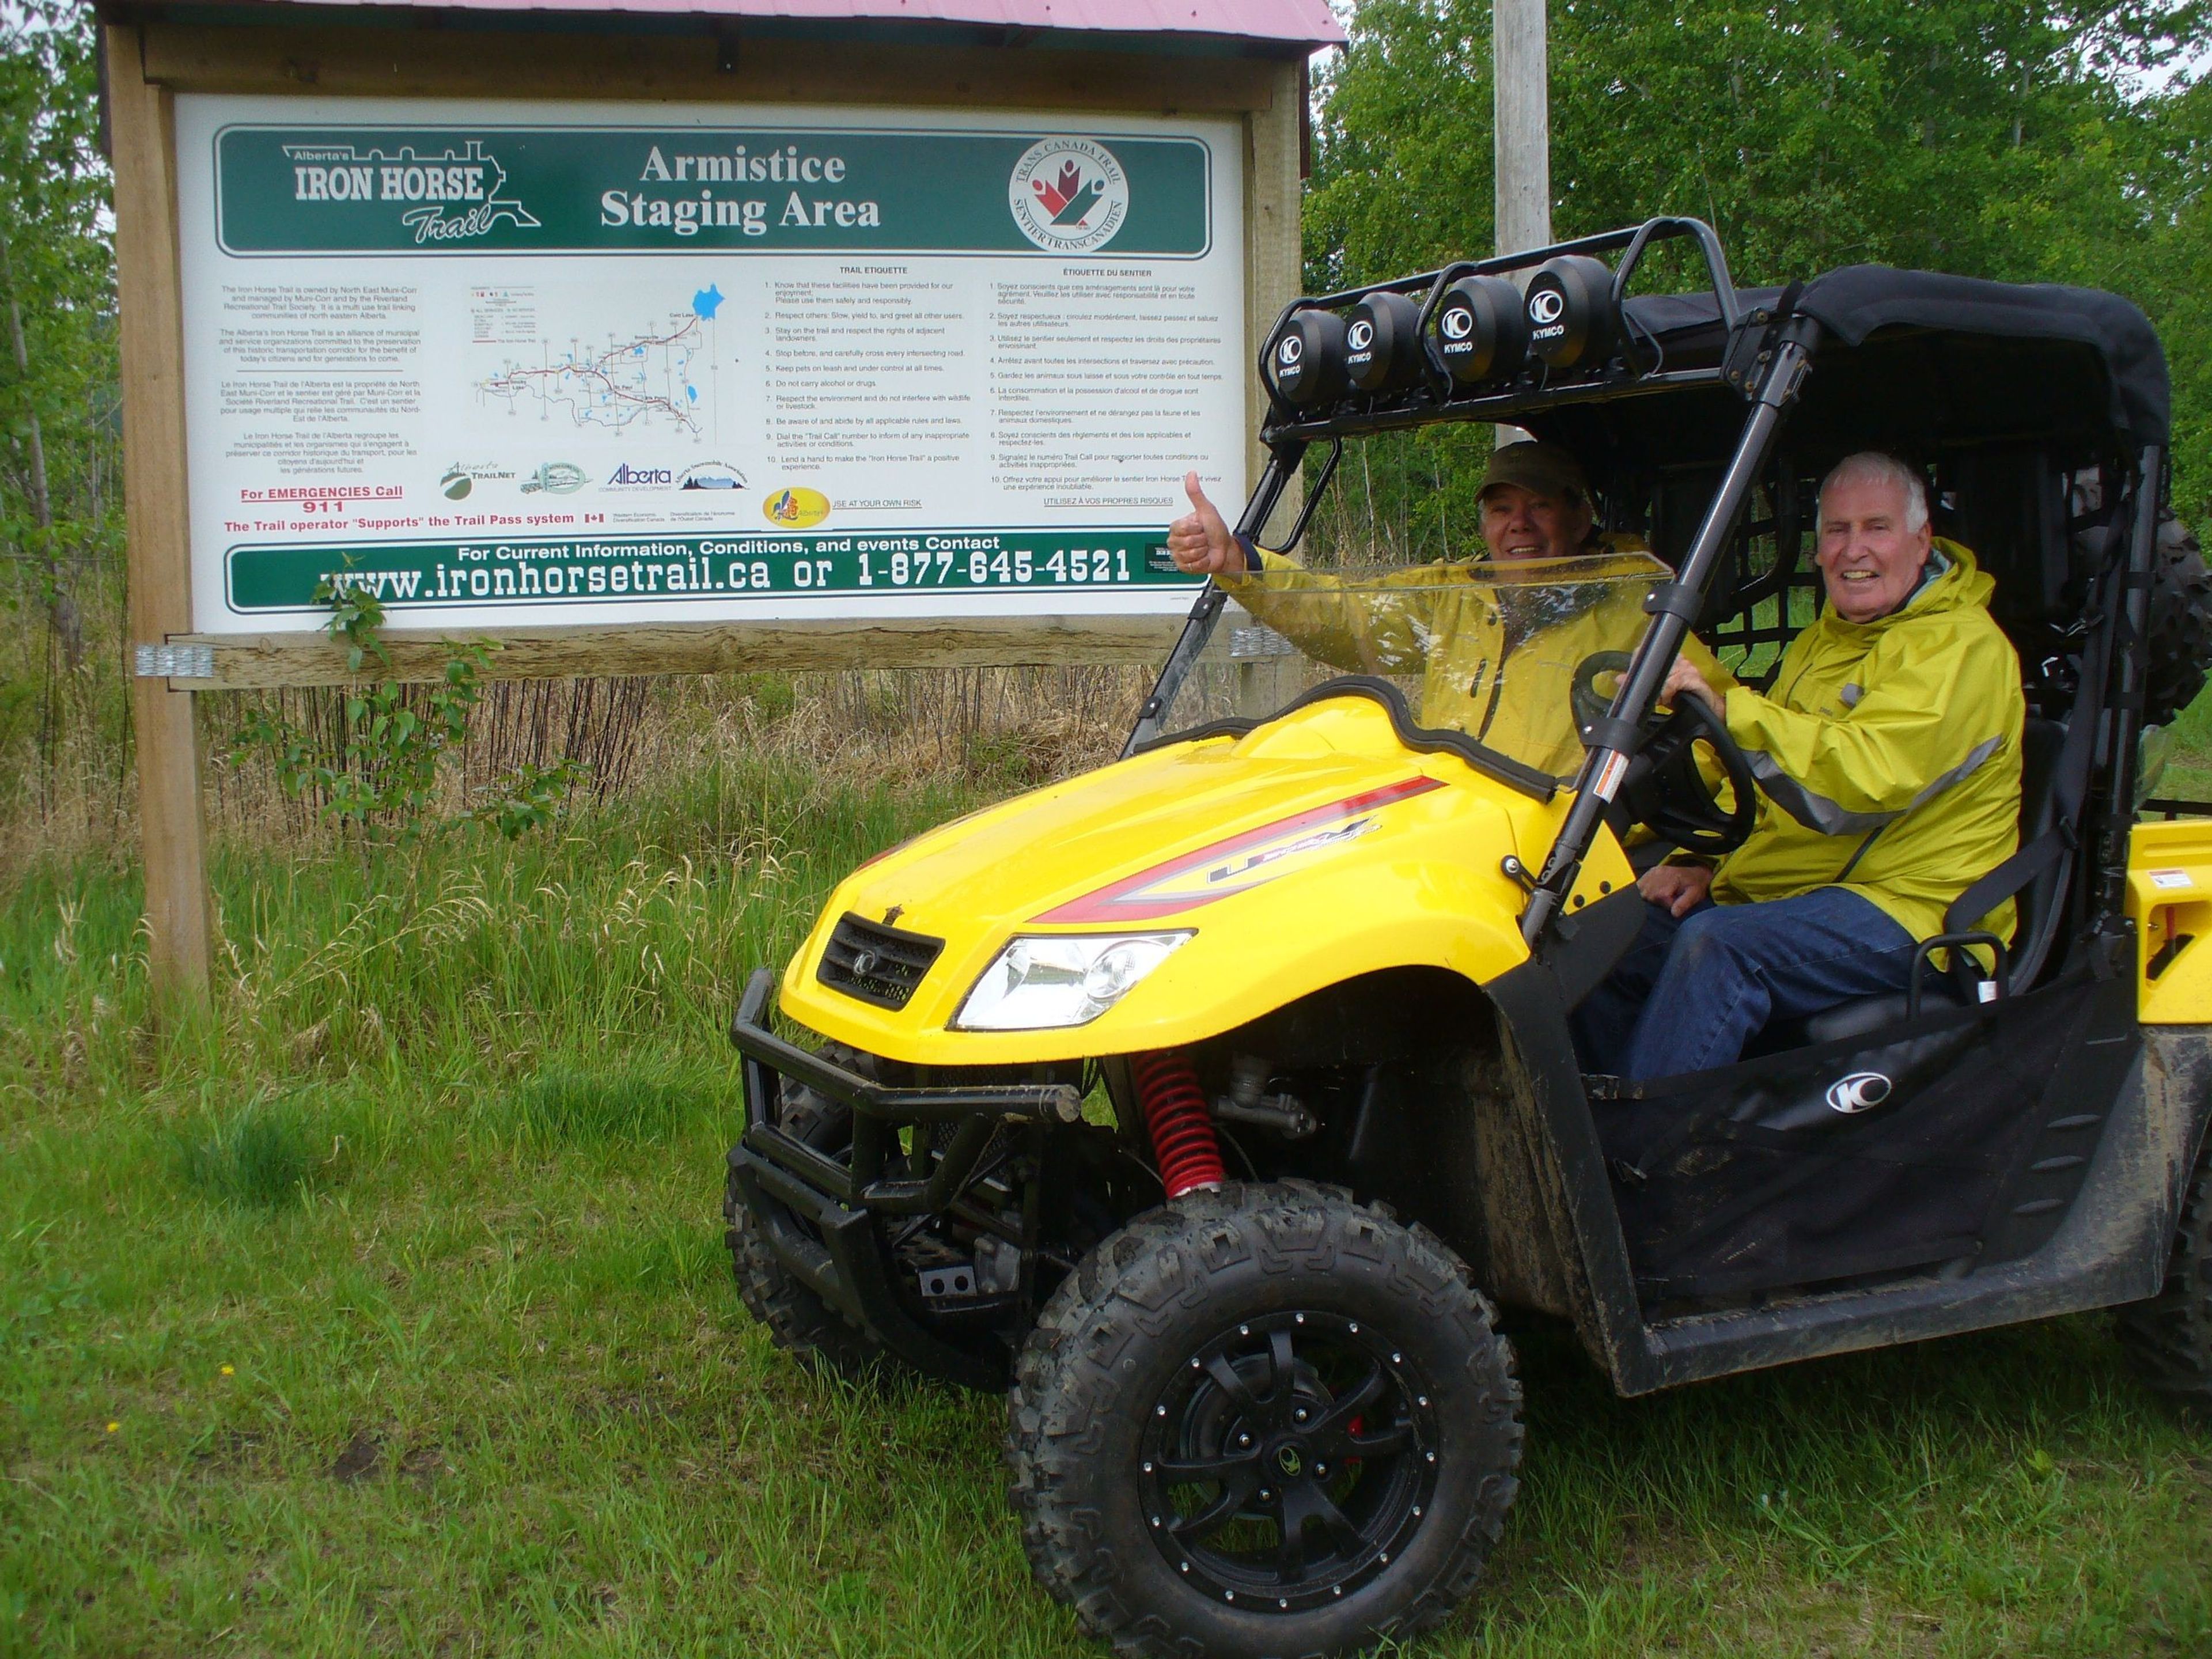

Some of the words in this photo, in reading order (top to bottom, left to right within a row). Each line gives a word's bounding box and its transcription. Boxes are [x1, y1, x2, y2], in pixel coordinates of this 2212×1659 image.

[294, 151, 349, 161] Alberta's
[1016, 150, 1043, 183] TRANS
[1044, 140, 1095, 154] CANADA
[1098, 153, 1122, 185] TRAIL
[639, 147, 844, 182] Armistice
[296, 168, 373, 199] IRON
[381, 168, 483, 199] HORSE
[601, 191, 766, 235] Staging
[779, 192, 880, 226] Area
[403, 203, 493, 244] Trail
[1014, 198, 1046, 243] SENTIER
[1047, 202, 1123, 250] TRANSCANADIEN
[775, 312, 804, 320] Respect
[895, 312, 912, 320] greet
[385, 329, 419, 338] municipal
[1533, 324, 1565, 340] KYMCO
[263, 338, 312, 346] organizations
[376, 339, 421, 347] preservation
[1444, 342, 1473, 354] KYMCO
[1348, 351, 1372, 365] KYMCO
[1279, 365, 1301, 378] KYMCO
[608, 463, 672, 484] Alberta
[241, 490, 263, 499] For
[269, 487, 370, 498] EMERGENCIES
[376, 486, 403, 497] Call
[302, 501, 344, 513] 911
[1140, 497, 1173, 505] RISQUES
[224, 521, 249, 531] The
[253, 520, 285, 531] Trail
[290, 520, 348, 531] operator
[353, 517, 423, 530] "Supports"
[429, 516, 449, 526] the
[454, 515, 484, 525] Trail
[490, 514, 521, 524] Pass
[527, 513, 573, 525] system
[459, 544, 490, 560] For
[496, 542, 569, 559] Current
[576, 541, 693, 559] Information,
[699, 539, 808, 555] Conditions,
[816, 539, 850, 552] and
[857, 538, 919, 554] events
[926, 536, 999, 553] Contact
[320, 557, 770, 600] www.ironhorsetrail.ca
[794, 560, 832, 588] or
[858, 549, 1130, 586] 1-877-645-4521
